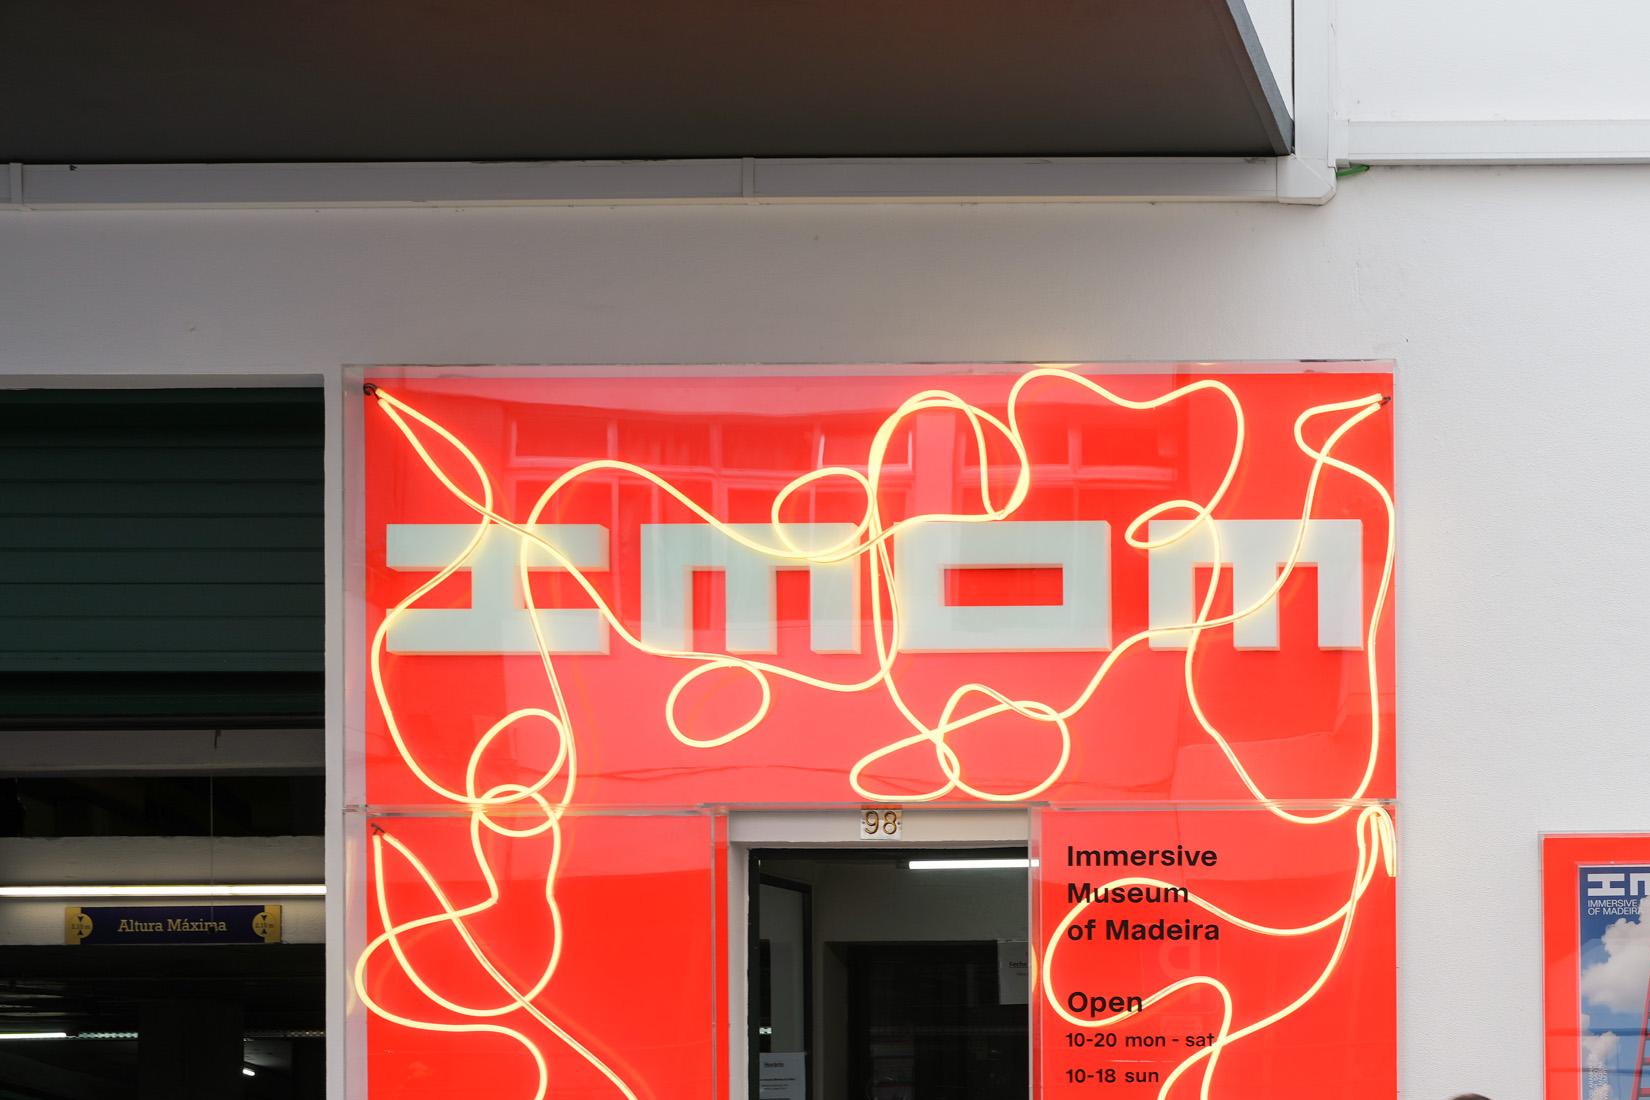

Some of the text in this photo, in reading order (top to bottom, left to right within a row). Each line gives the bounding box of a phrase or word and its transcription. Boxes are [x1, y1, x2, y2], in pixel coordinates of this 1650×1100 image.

[865, 811, 897, 835] 98
[1067, 845, 1218, 867] Immersive
[1067, 883, 1189, 903] Museum
[1587, 899, 1639, 908] IMMERSIVE
[1587, 907, 1600, 916] OF
[117, 917, 228, 933] Altura Máxima
[1067, 918, 1220, 941] of Madeira
[1068, 990, 1143, 1018] Open
[1066, 1032, 1117, 1048] 10-20
[1125, 1034, 1166, 1047] mon
[1185, 1032, 1215, 1047] sat
[1066, 1068, 1159, 1084] 10-18 sun
